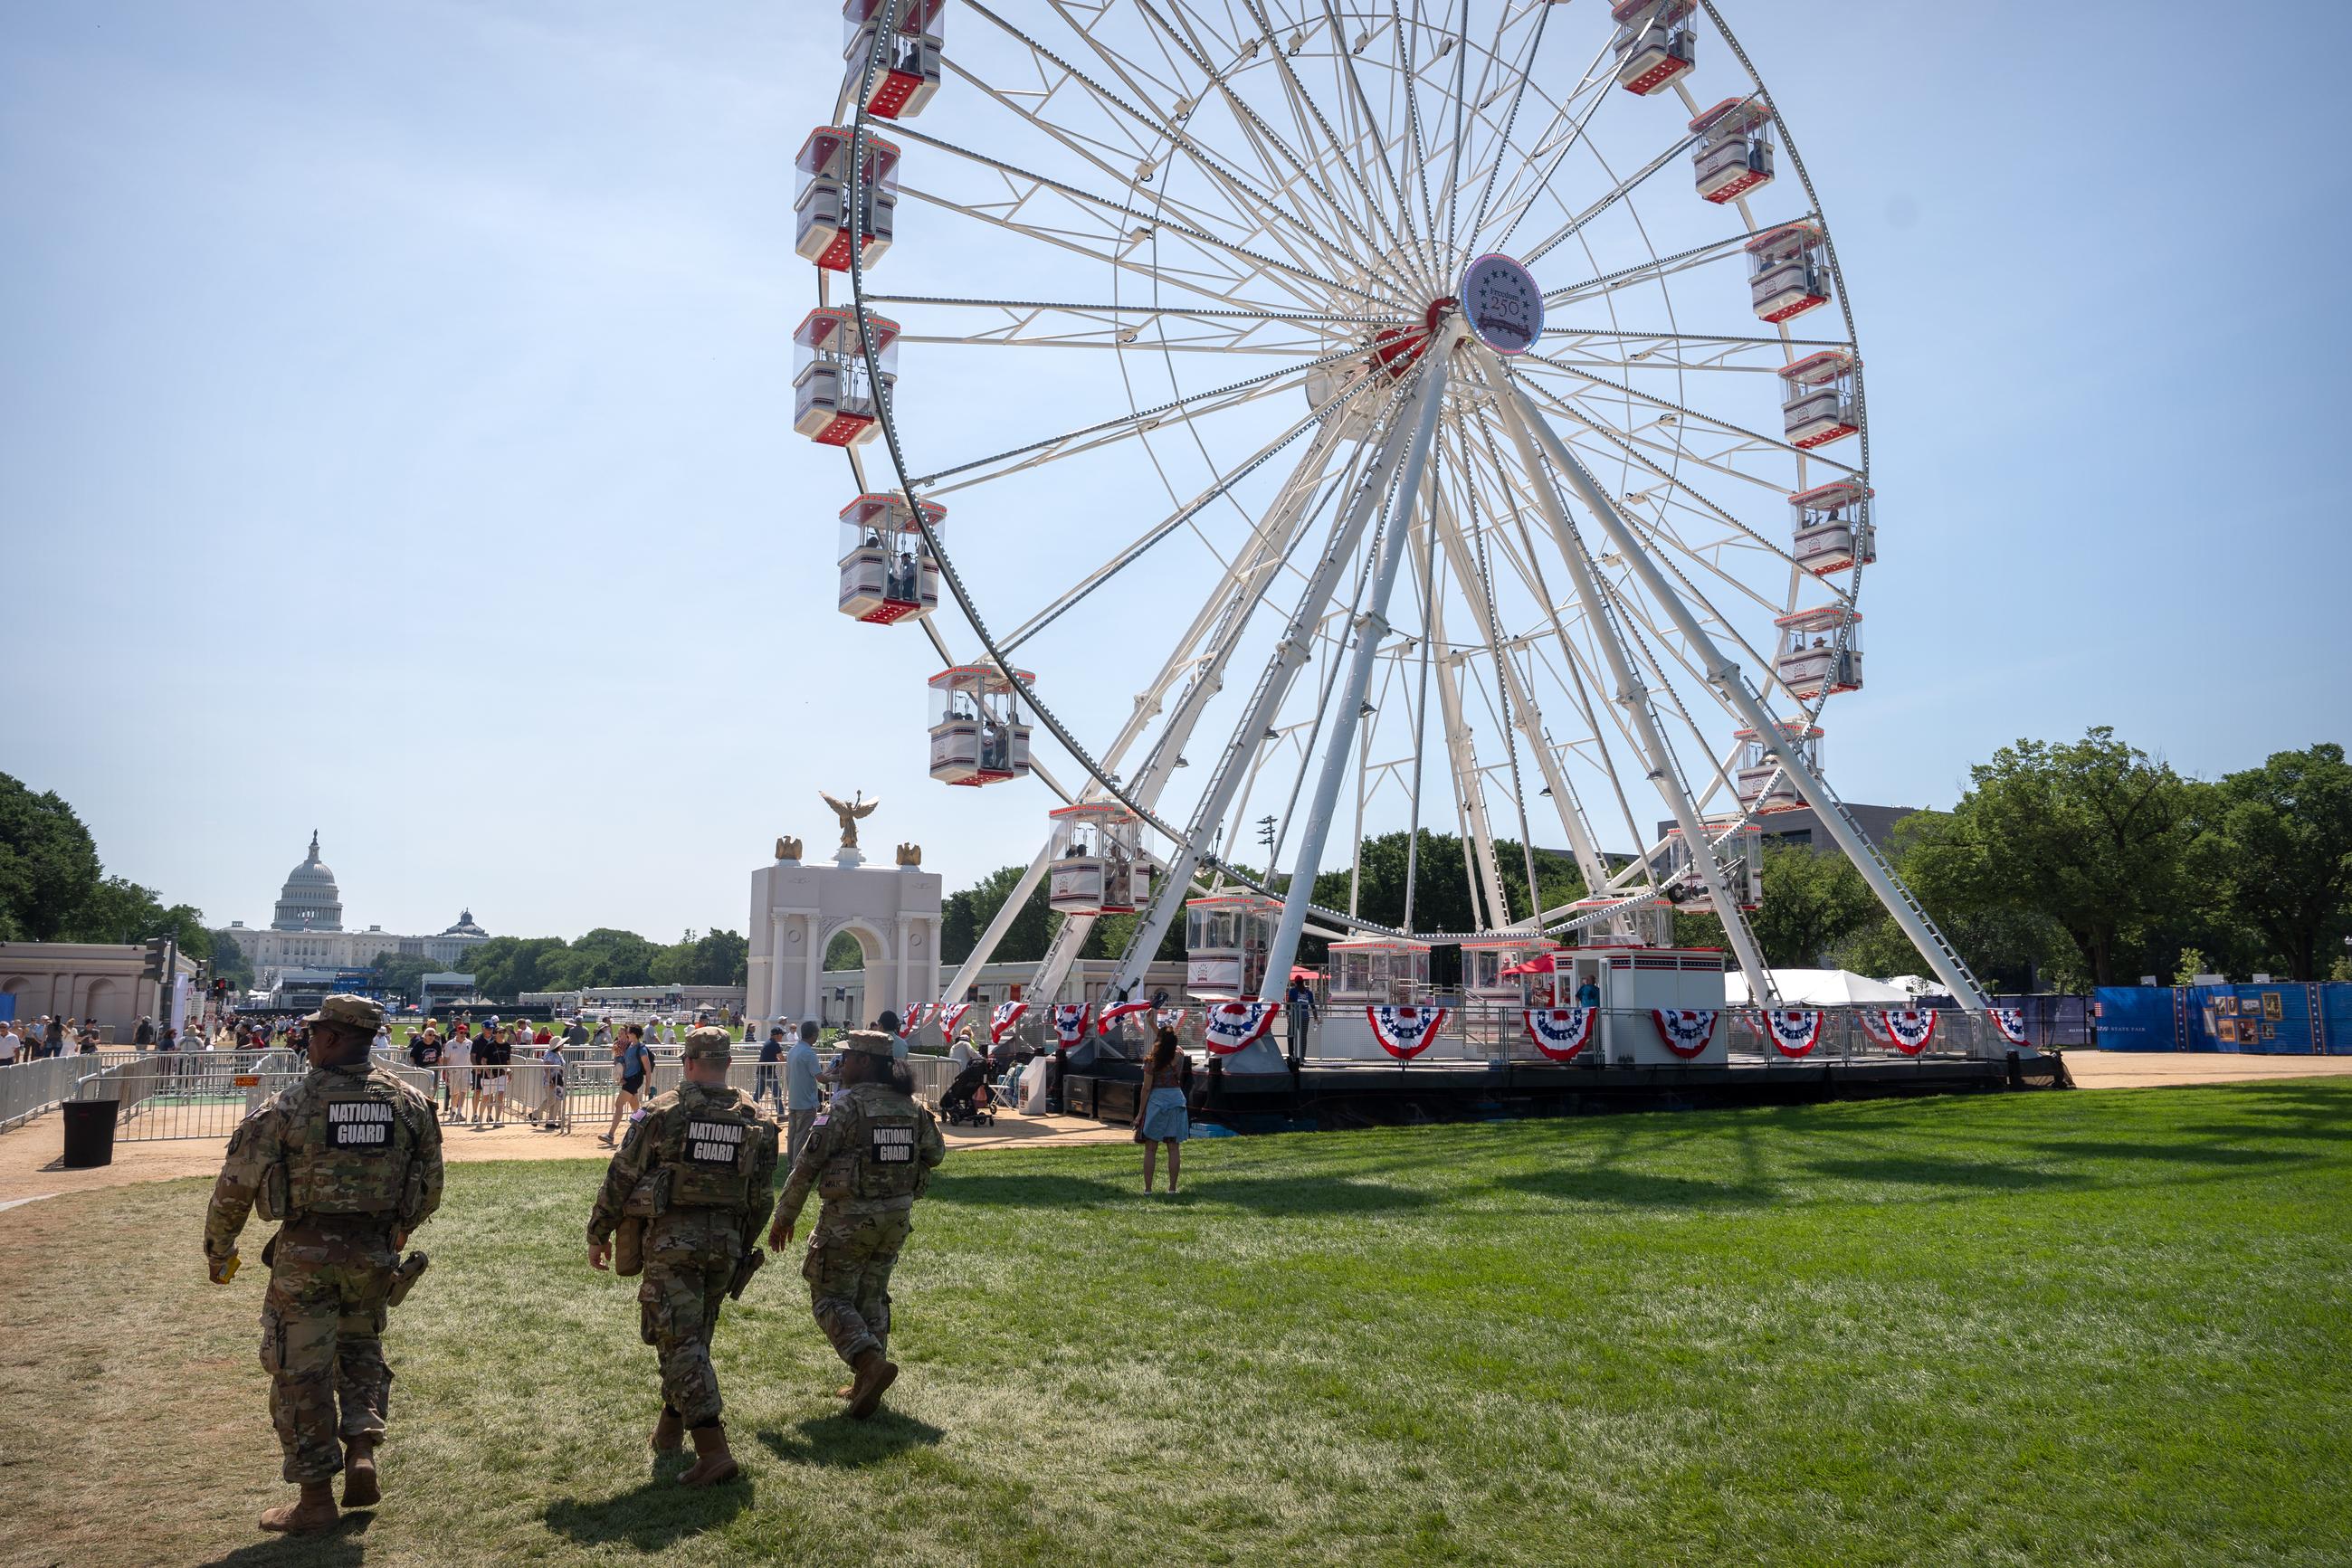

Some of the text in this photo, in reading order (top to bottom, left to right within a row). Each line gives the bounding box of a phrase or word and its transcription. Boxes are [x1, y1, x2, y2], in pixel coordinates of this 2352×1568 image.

[1490, 287, 1519, 301] Freedom
[1490, 296, 1519, 317] 250
[329, 1103, 394, 1122] NATIONAL
[338, 1125, 386, 1144] GUARD
[873, 1128, 914, 1145] NATIONAL
[693, 1142, 735, 1162] GUARD
[880, 1145, 909, 1161] GUARD
